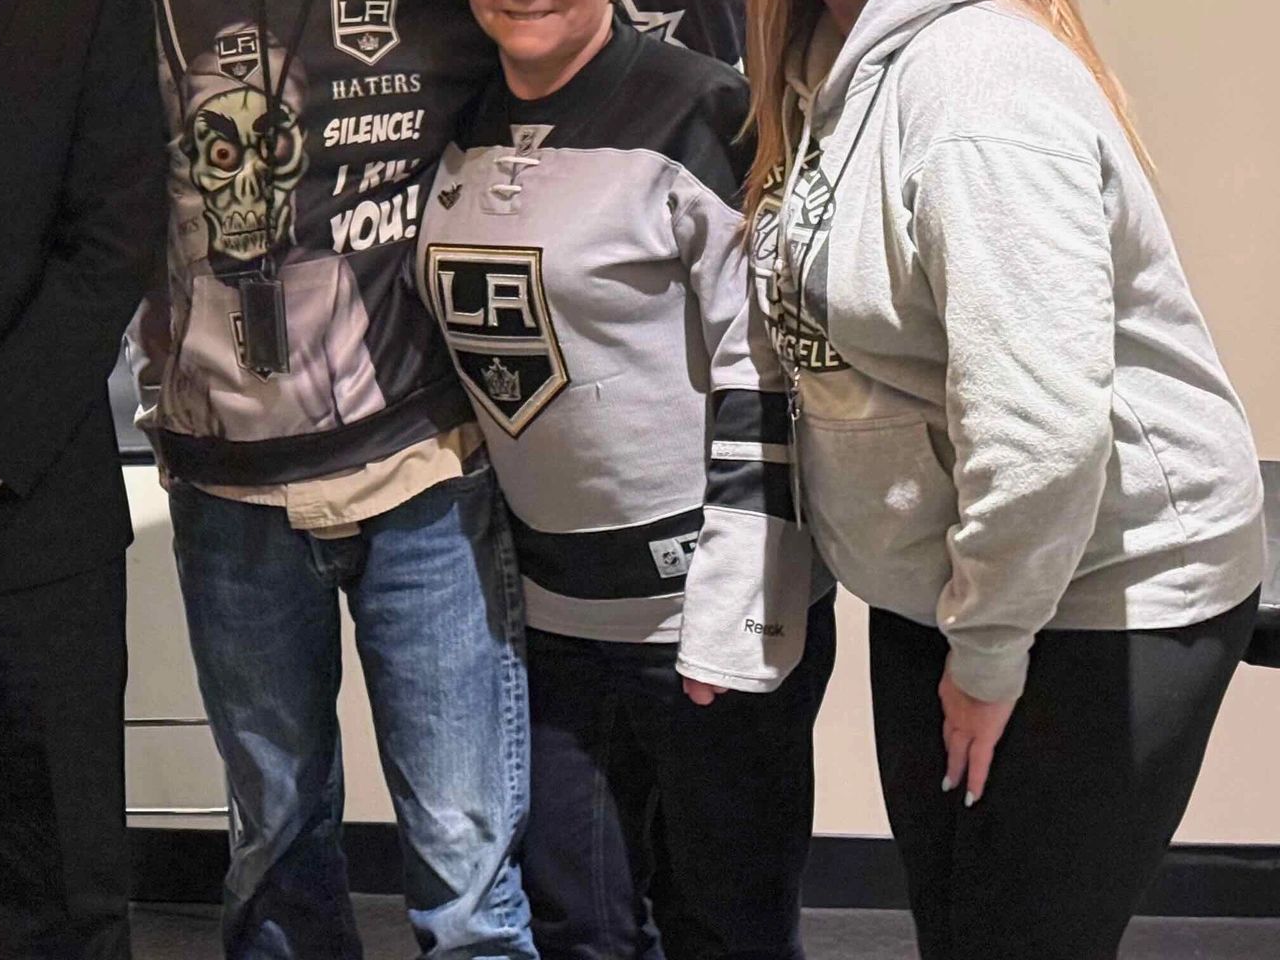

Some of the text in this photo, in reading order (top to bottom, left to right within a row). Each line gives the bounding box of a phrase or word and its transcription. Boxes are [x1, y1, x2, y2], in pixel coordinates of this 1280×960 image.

[339, 0, 390, 24] LA
[220, 36, 256, 56] LA
[332, 73, 421, 100] HATERS
[323, 109, 425, 147] SILENCE!
[332, 157, 420, 196] I KIL
[330, 184, 420, 254] YOU!
[438, 270, 538, 328] LA
